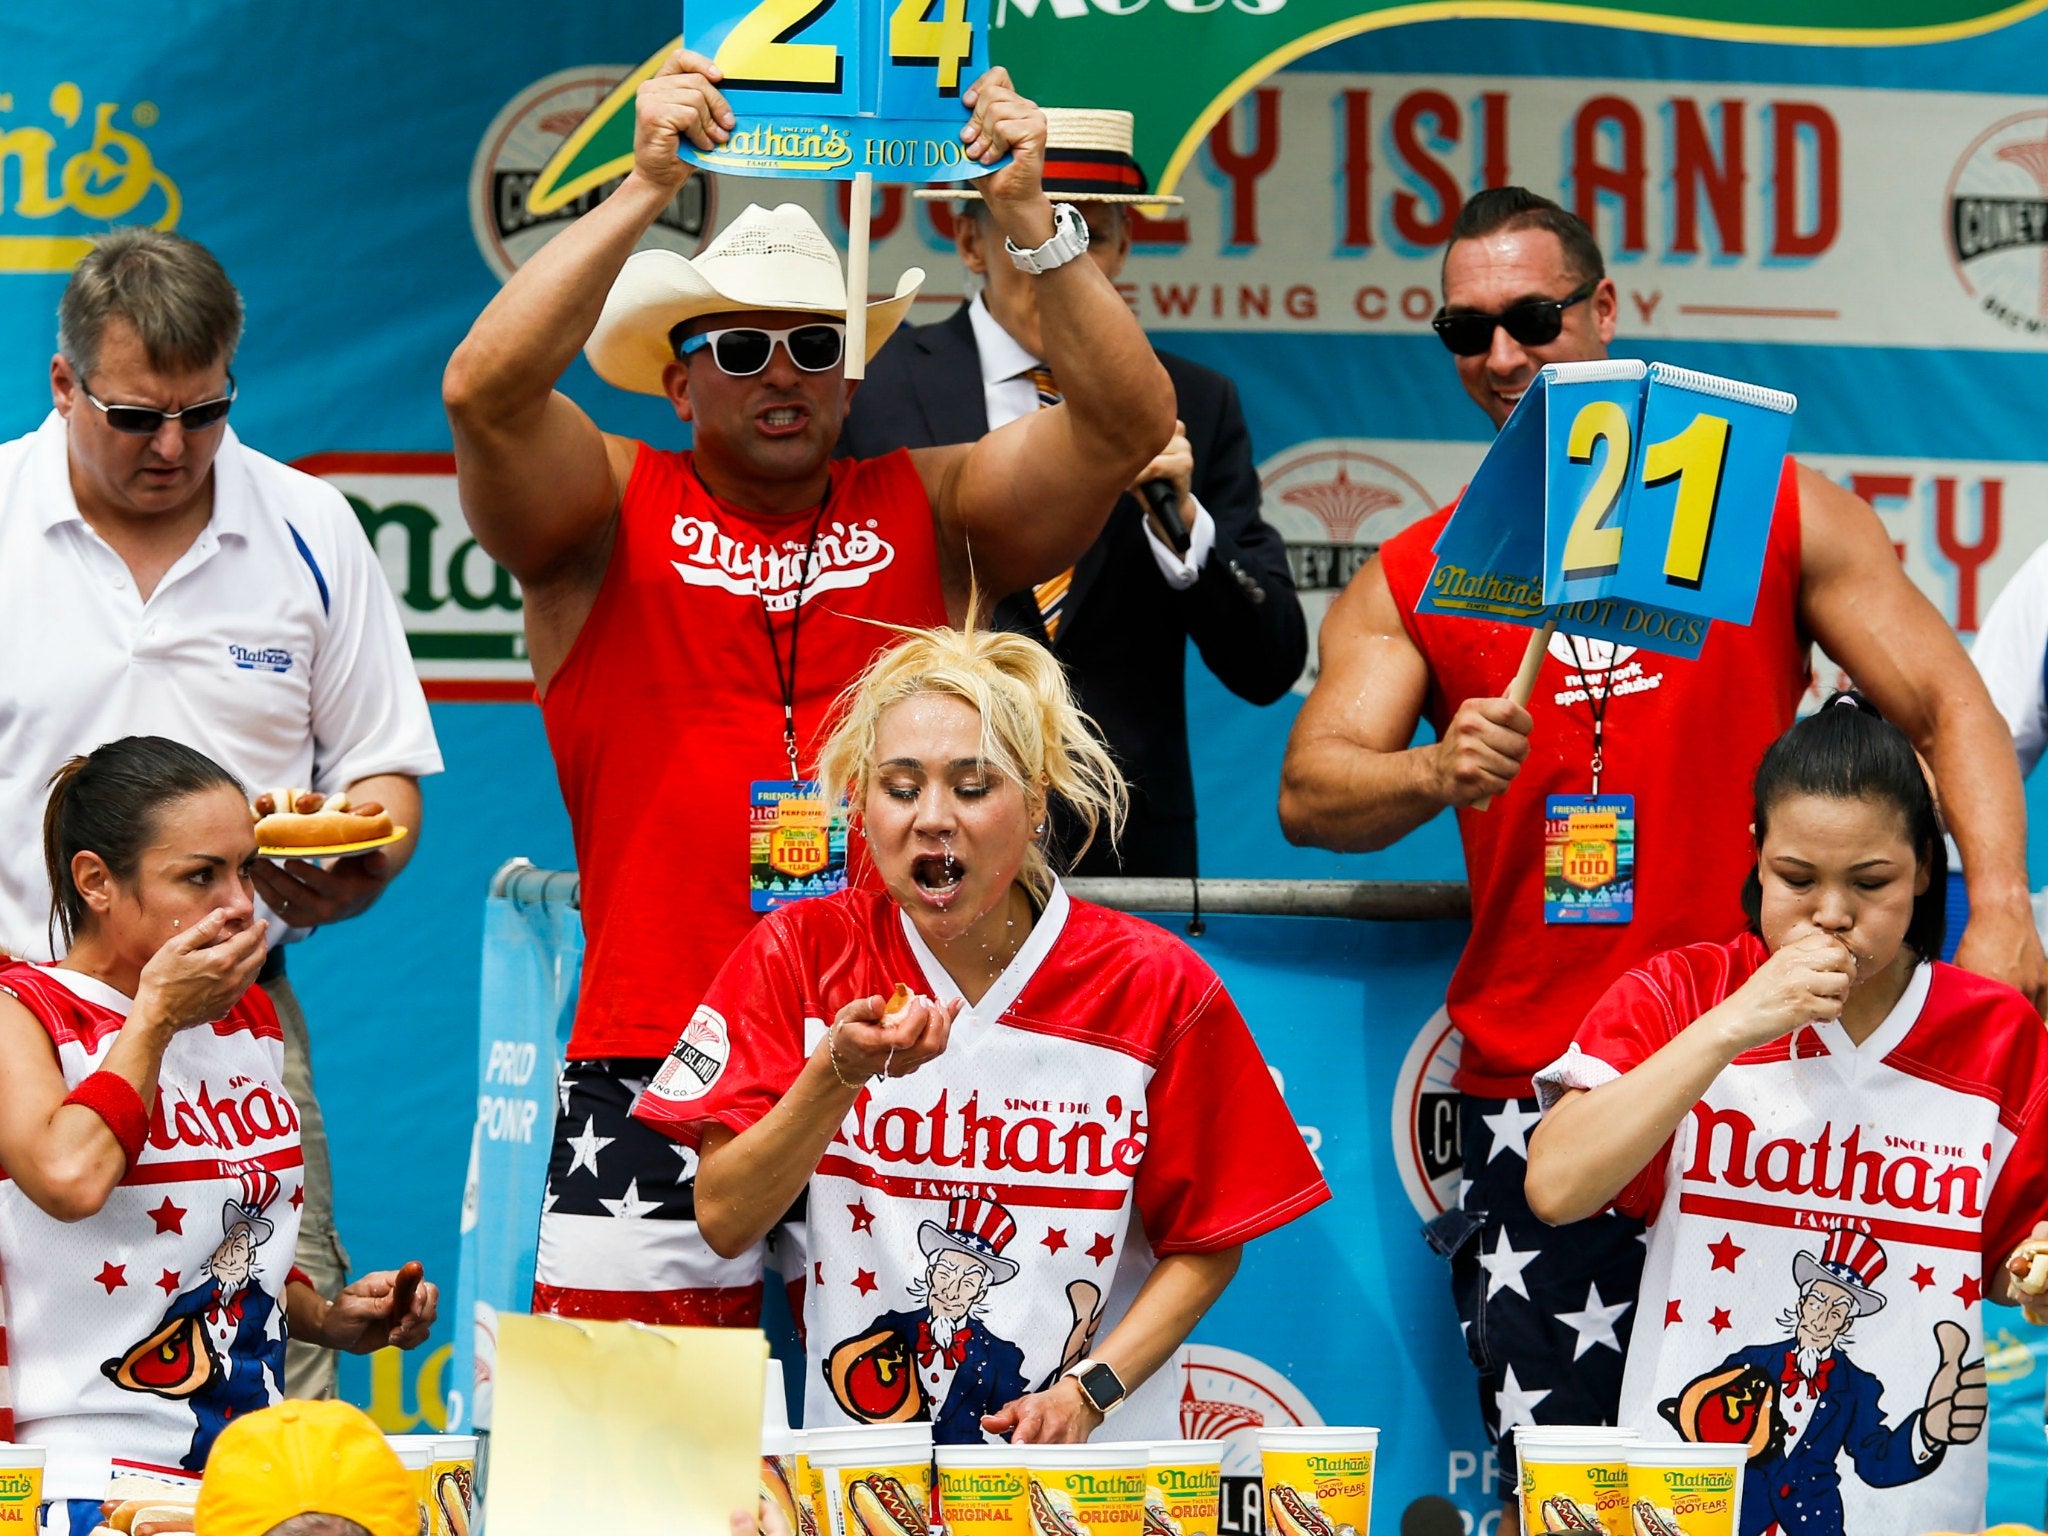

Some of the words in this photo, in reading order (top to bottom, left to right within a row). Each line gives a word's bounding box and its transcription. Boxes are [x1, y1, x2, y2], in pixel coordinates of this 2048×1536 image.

[865, 139, 917, 167] HOT
[924, 141, 970, 167] DO
[1564, 401, 1731, 588] 21
[1434, 565, 1543, 606] Nathan's
[1555, 600, 1619, 626] HOT
[1622, 610, 1704, 645] DOGS
[758, 792, 797, 800] FRIENDS
[1552, 805, 1587, 814] FRIENDS
[1597, 805, 1627, 814] FAMILY
[778, 848, 820, 862] 100
[1570, 860, 1608, 875] 100
[681, 1046, 719, 1083] ISLAND
[1004, 1098, 1053, 1114] SINCE
[1058, 1100, 1091, 1115] 1916
[1884, 1134, 1929, 1153] SINCE
[1933, 1142, 1967, 1159] 1916
[1306, 1456, 1371, 1471] Nathan's
[1663, 1471, 1733, 1487] Nathan's
[1315, 1488, 1338, 1500] 100
[1338, 1482, 1366, 1495] YEARS
[1595, 1499, 1616, 1512] 100
[1672, 1503, 1695, 1516] 100
[1695, 1499, 1727, 1511] YEARS
[944, 1508, 1013, 1521] ORIGINAL
[1079, 1509, 1142, 1524] ORIGINAL
